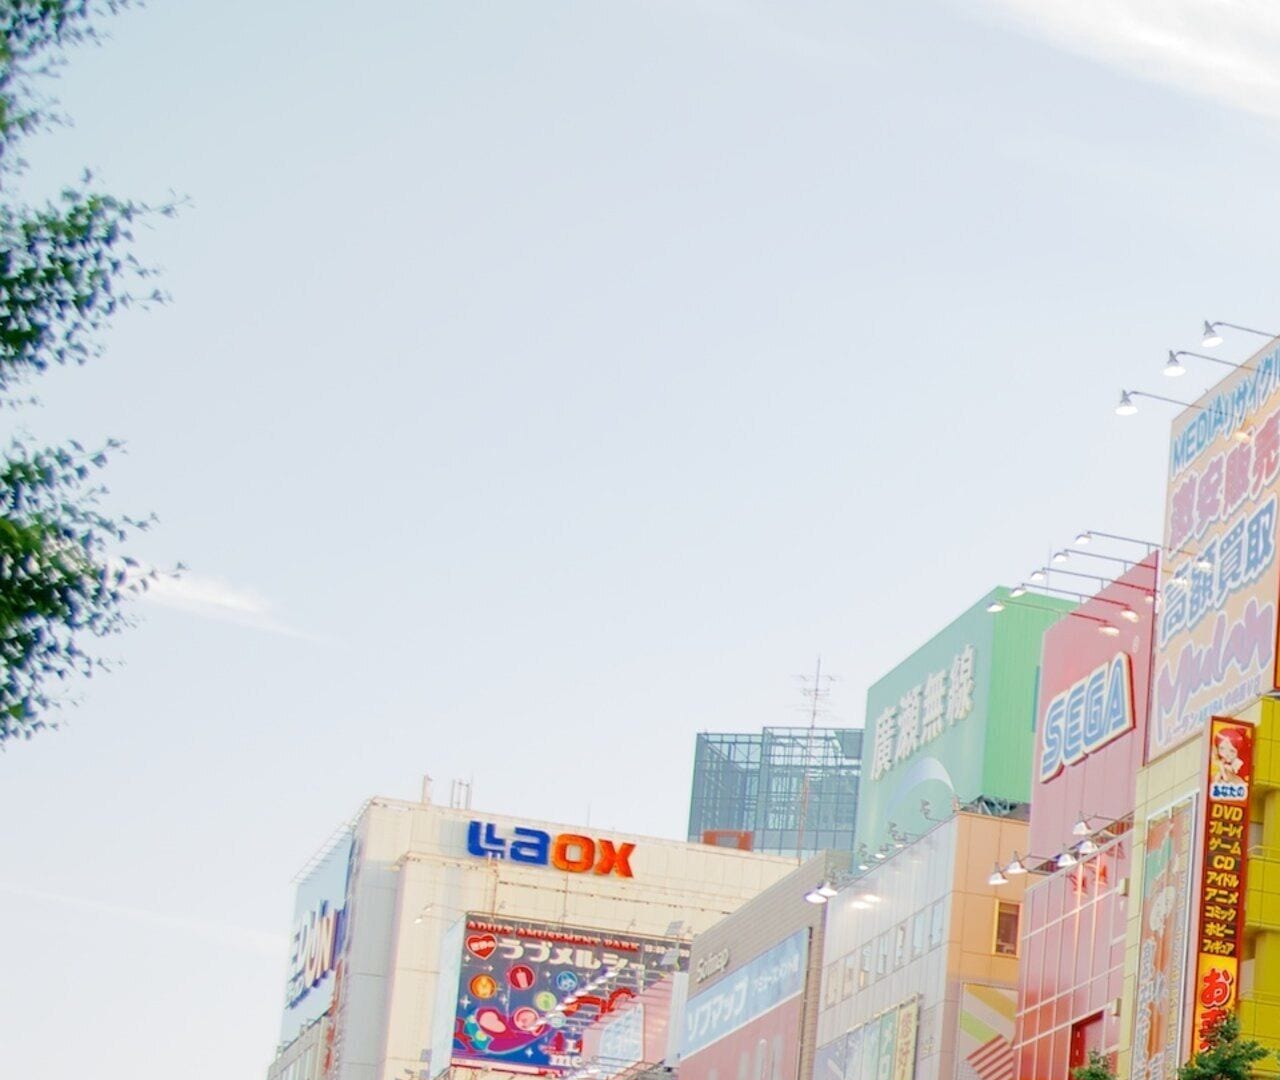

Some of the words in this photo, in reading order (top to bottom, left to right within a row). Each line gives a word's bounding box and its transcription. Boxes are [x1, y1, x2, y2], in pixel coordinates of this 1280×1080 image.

[1042, 653, 1131, 780] SEGA
[1212, 785, 1245, 798] あなたの
[1211, 803, 1243, 821] DVD
[1209, 820, 1243, 839] ブルーレイ
[1209, 837, 1242, 856] ゲーム
[1213, 855, 1235, 870] CD
[1207, 870, 1239, 888] アイドル
[1205, 887, 1239, 904] アニメ
[1205, 905, 1237, 921] コミック
[1205, 922, 1235, 937] ホビー
[1202, 939, 1235, 955] フィギュア
